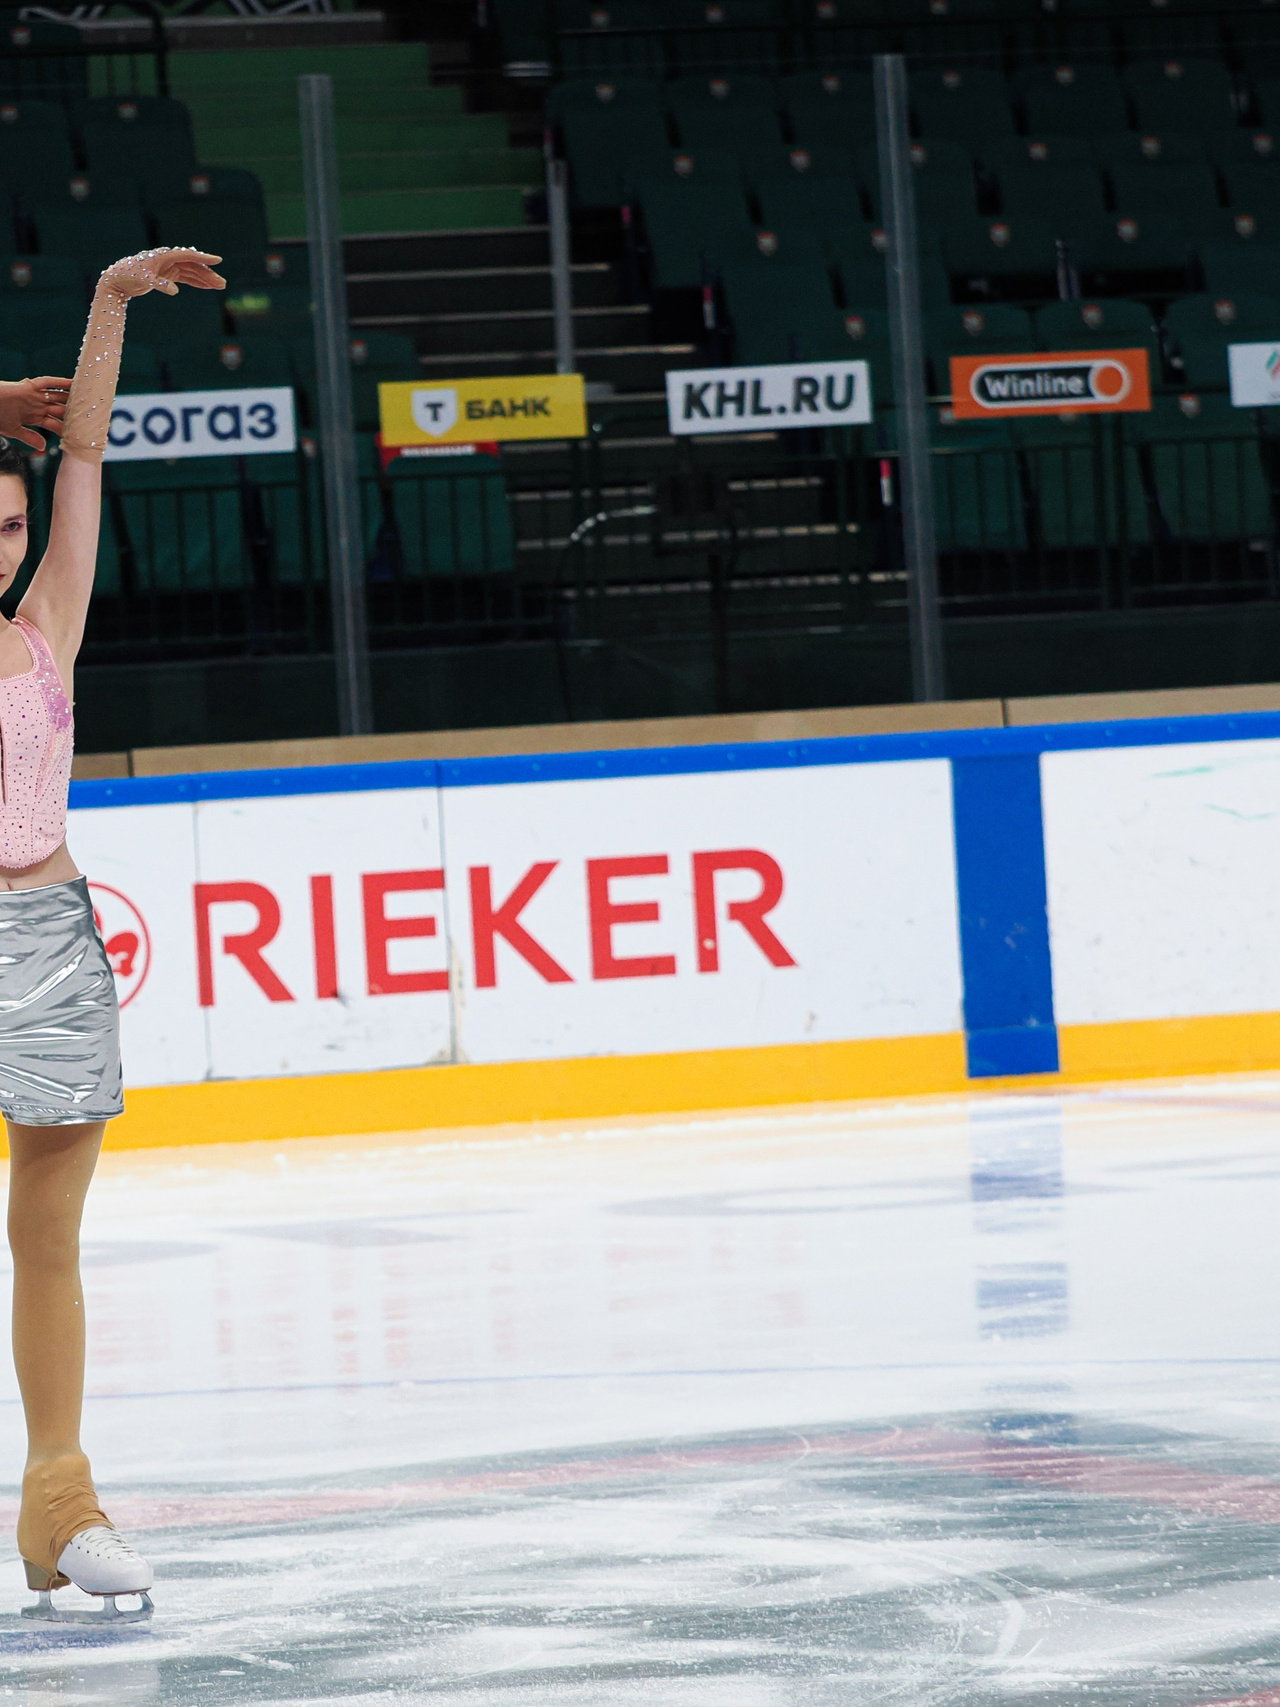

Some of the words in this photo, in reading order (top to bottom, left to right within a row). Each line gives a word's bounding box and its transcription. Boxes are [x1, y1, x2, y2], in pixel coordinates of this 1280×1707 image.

[681, 373, 856, 421] KHL.RU
[983, 370, 1085, 400] Winline
[466, 396, 552, 421] БАНК
[192, 847, 799, 1009] RIEKER
